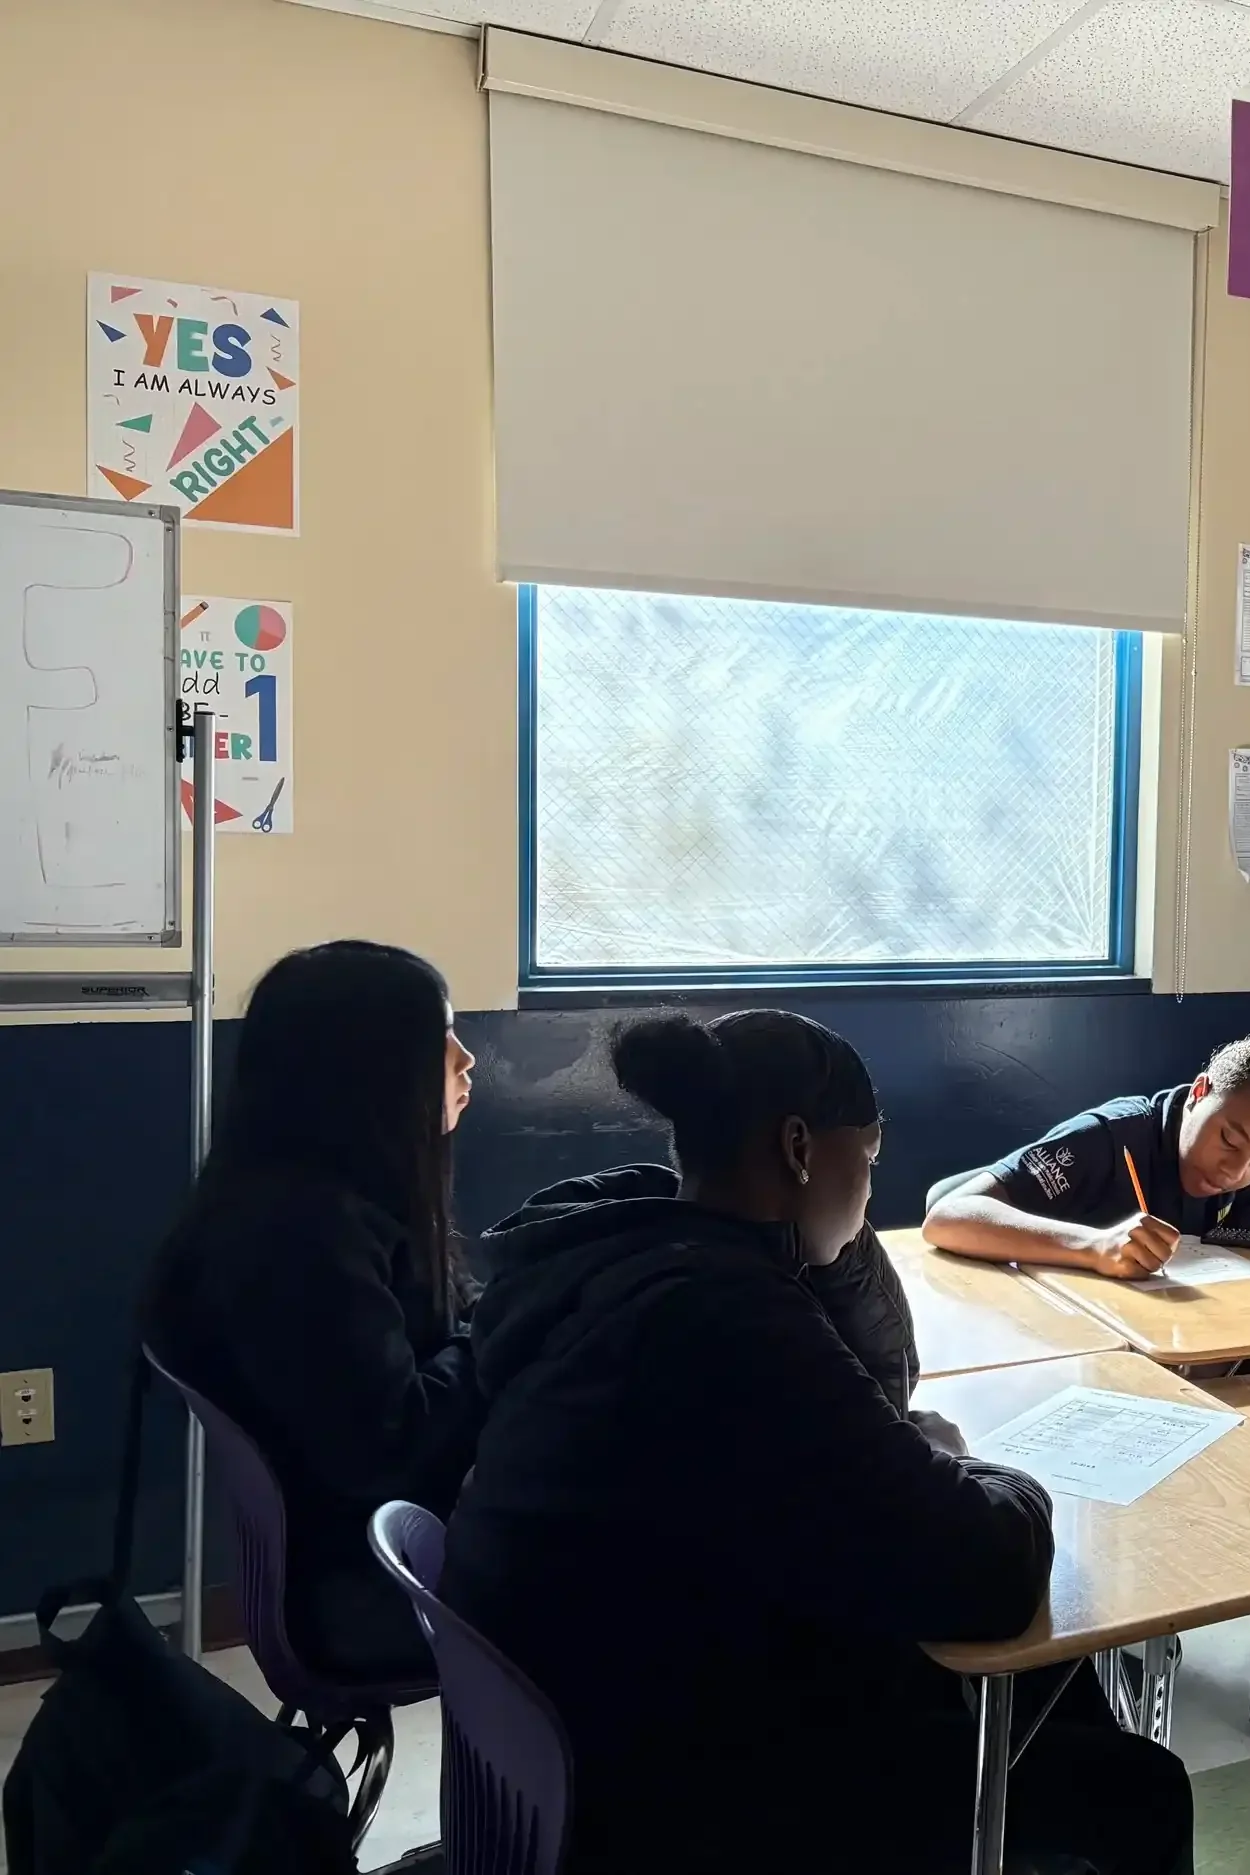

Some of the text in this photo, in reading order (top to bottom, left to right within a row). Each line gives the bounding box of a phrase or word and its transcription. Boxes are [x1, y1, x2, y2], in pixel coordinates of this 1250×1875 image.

[133, 313, 252, 378] YES
[113, 368, 276, 406] I AM ALWAYS
[169, 415, 270, 503] RIGHT
[180, 649, 266, 673] AVE TO
[182, 670, 220, 695] dd
[245, 674, 277, 762] 1
[81, 986, 150, 997] SUPERIOR
[1033, 1146, 1071, 1192] ALLIANCE
